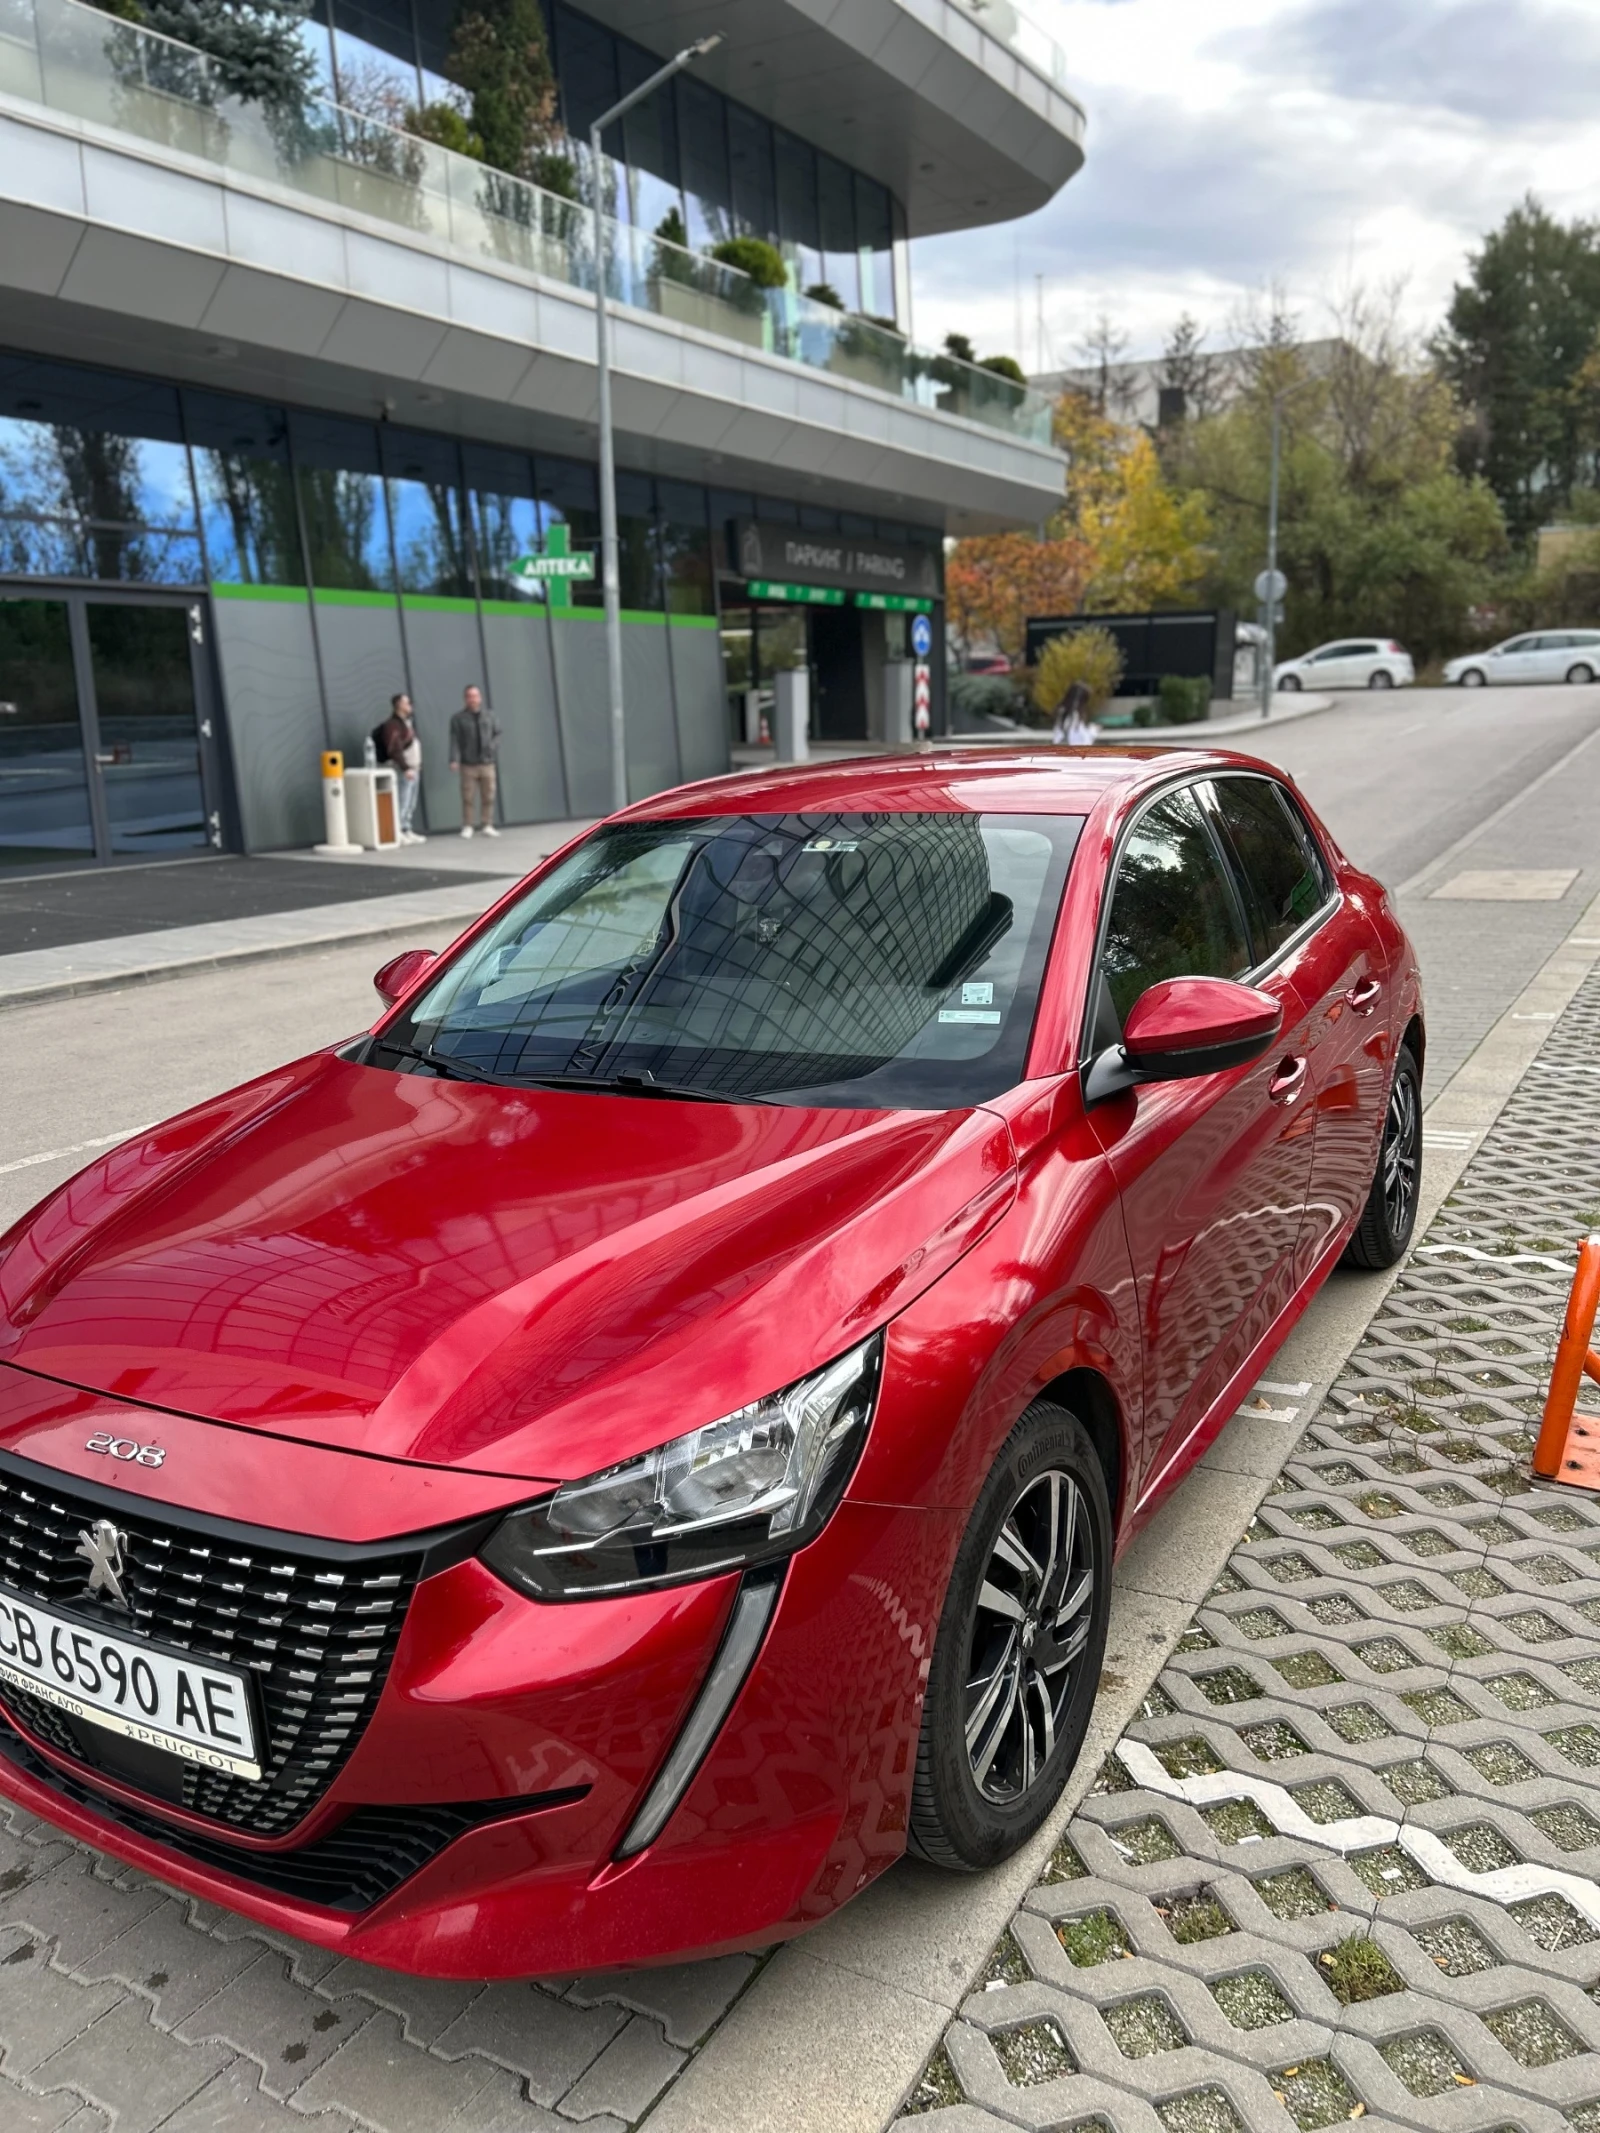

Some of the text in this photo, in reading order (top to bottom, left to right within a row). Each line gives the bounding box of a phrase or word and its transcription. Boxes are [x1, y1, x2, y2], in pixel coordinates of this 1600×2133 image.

[524, 558, 590, 575] АПТЕКА
[85, 1431, 166, 1468] 208
[1018, 1430, 1065, 1478] Continental
[0, 1601, 242, 1745] CB 6590 AE
[21, 1677, 56, 1702] ФРАНС
[58, 1696, 83, 1716] АУТО
[138, 1729, 237, 1771] PEUGEOT
